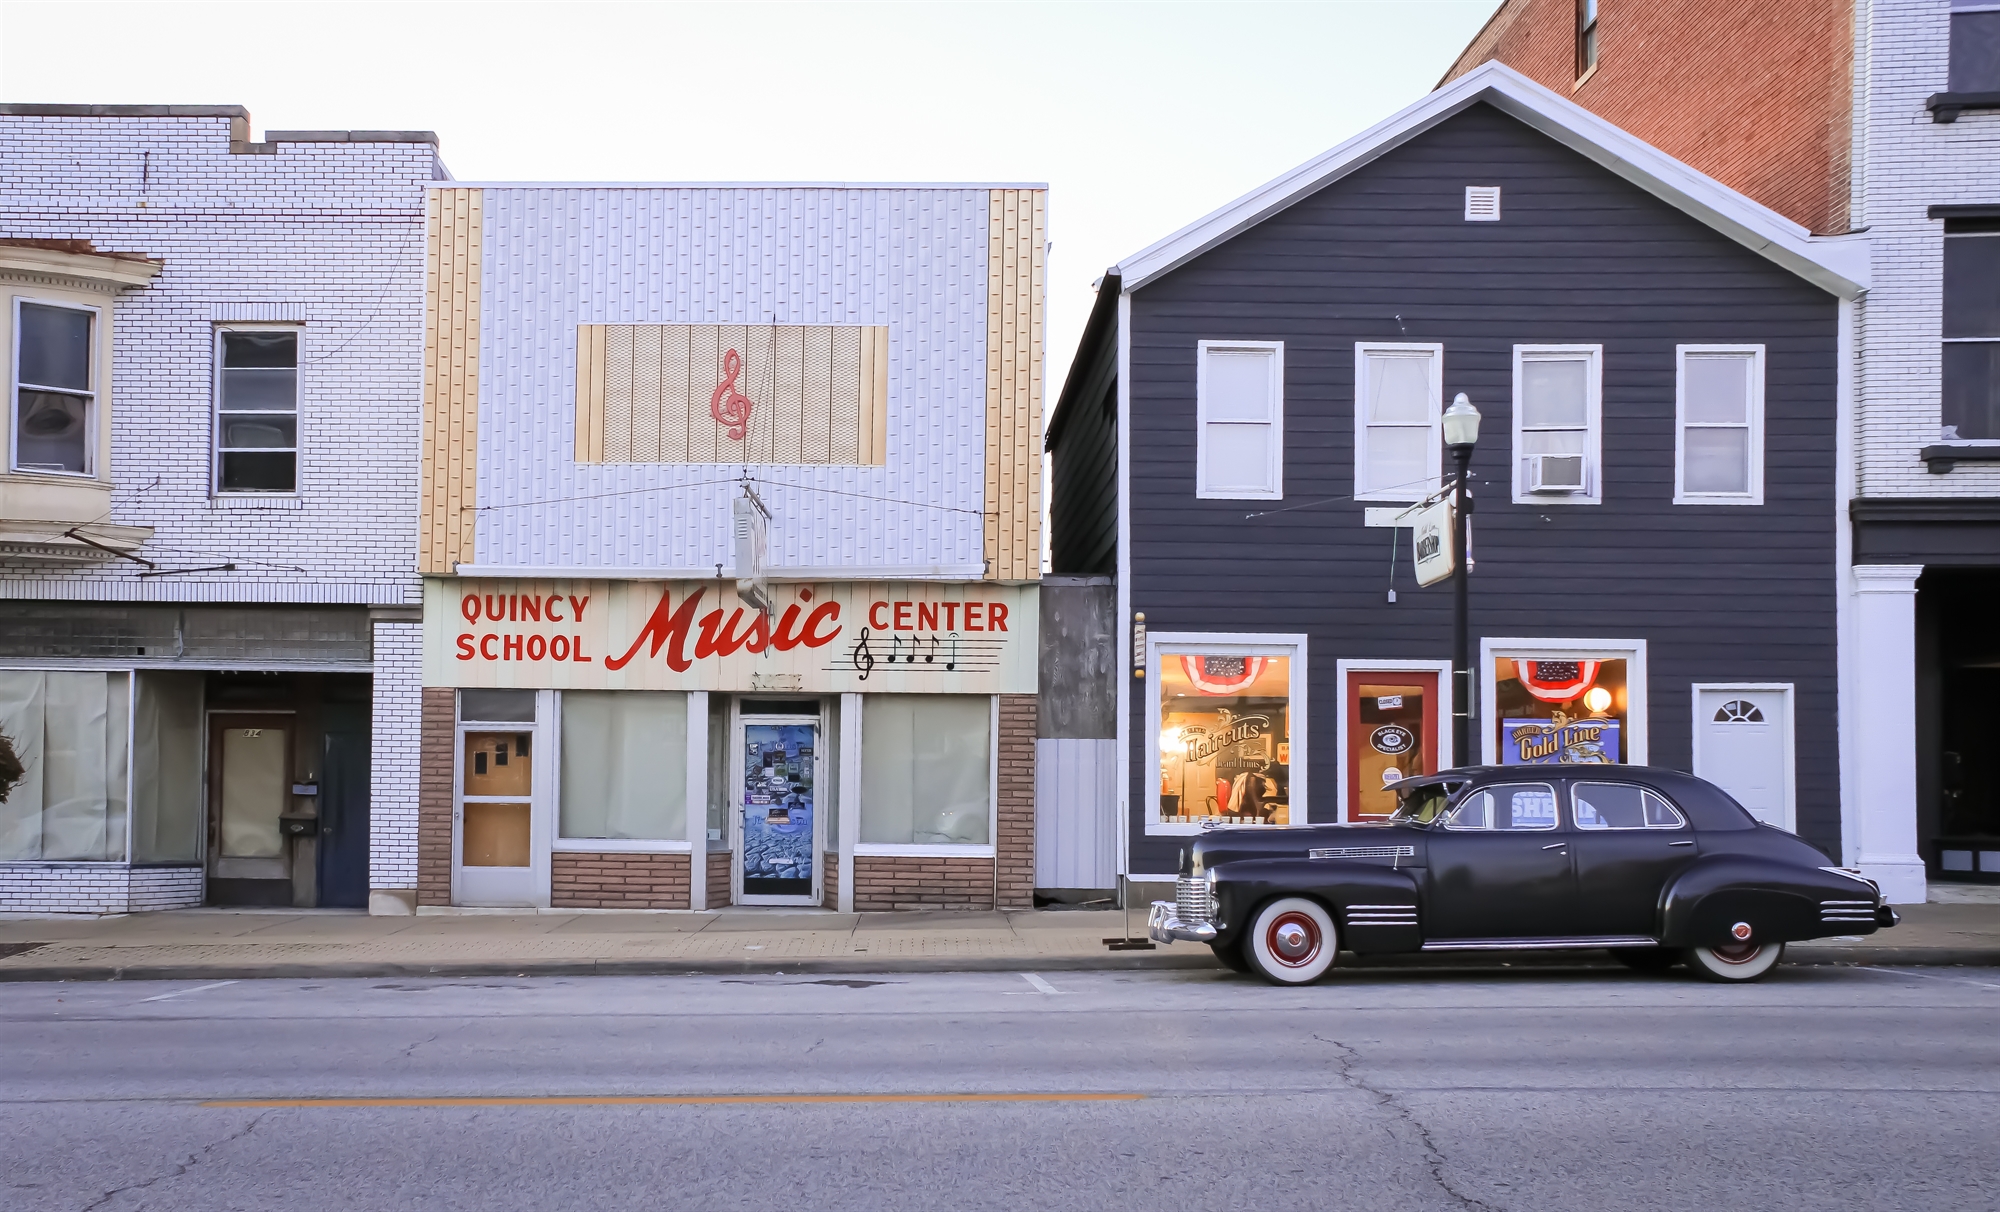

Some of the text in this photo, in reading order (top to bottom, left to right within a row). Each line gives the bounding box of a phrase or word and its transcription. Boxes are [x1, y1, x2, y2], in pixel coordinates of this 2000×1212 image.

[461, 594, 590, 625] QUINCY
[868, 601, 1009, 632] CENTER
[604, 586, 842, 673] Music
[455, 633, 592, 662] SCHOOL
[243, 729, 262, 737] 834
[1186, 722, 1260, 762] Haircuts
[1376, 743, 1406, 752] SPECIALIST
[1377, 728, 1406, 737] BLACK EYE
[1521, 732, 1558, 760] Gold
[1564, 726, 1600, 747] Line
